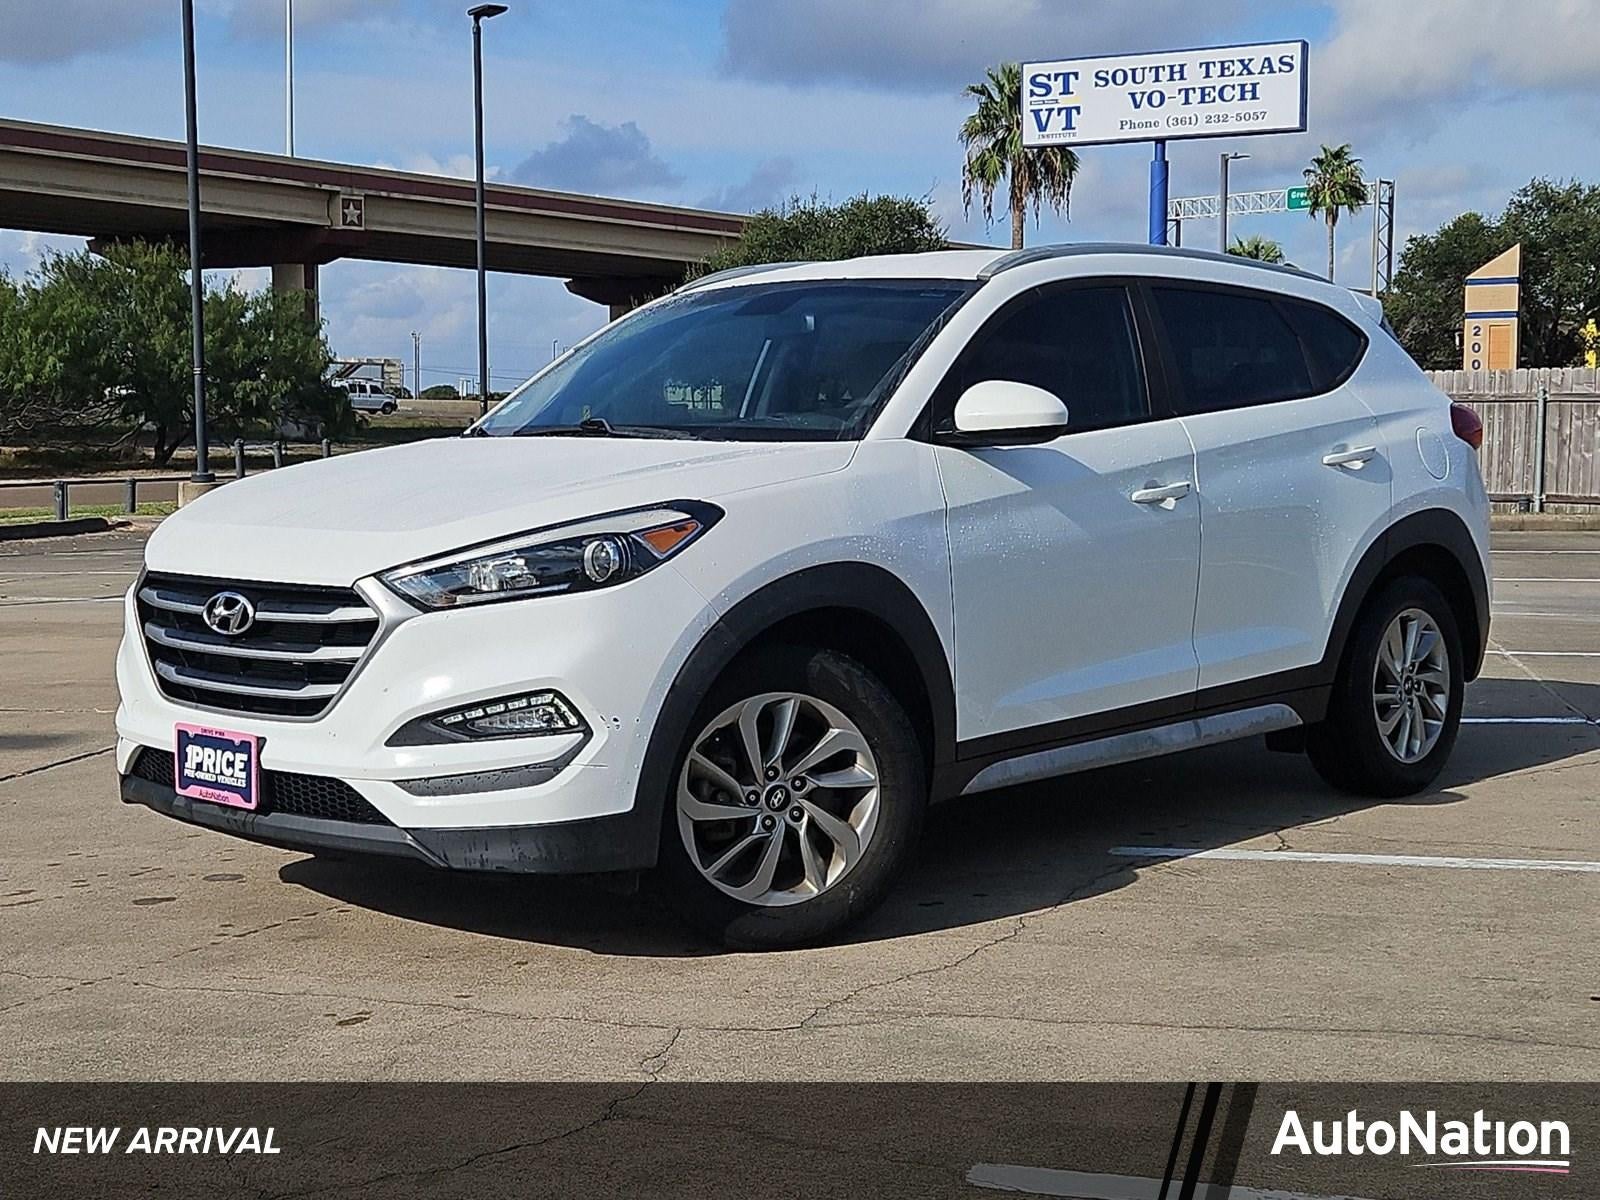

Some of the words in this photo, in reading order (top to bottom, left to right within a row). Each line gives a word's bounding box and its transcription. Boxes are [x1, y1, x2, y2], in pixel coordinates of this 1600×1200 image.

[1029, 71, 1079, 98] ST
[1094, 63, 1188, 88] SOUTH
[1199, 55, 1295, 80] TEXAS
[1127, 82, 1261, 110] VO-TECH
[1029, 105, 1081, 133] VT
[1119, 119, 1160, 130] Phone
[1166, 113, 1199, 127] (361)
[1204, 111, 1268, 125] 232-5057
[1037, 131, 1077, 140] INSTITUTE
[1472, 325, 1482, 370] 200
[198, 789, 230, 802] AutoNation
